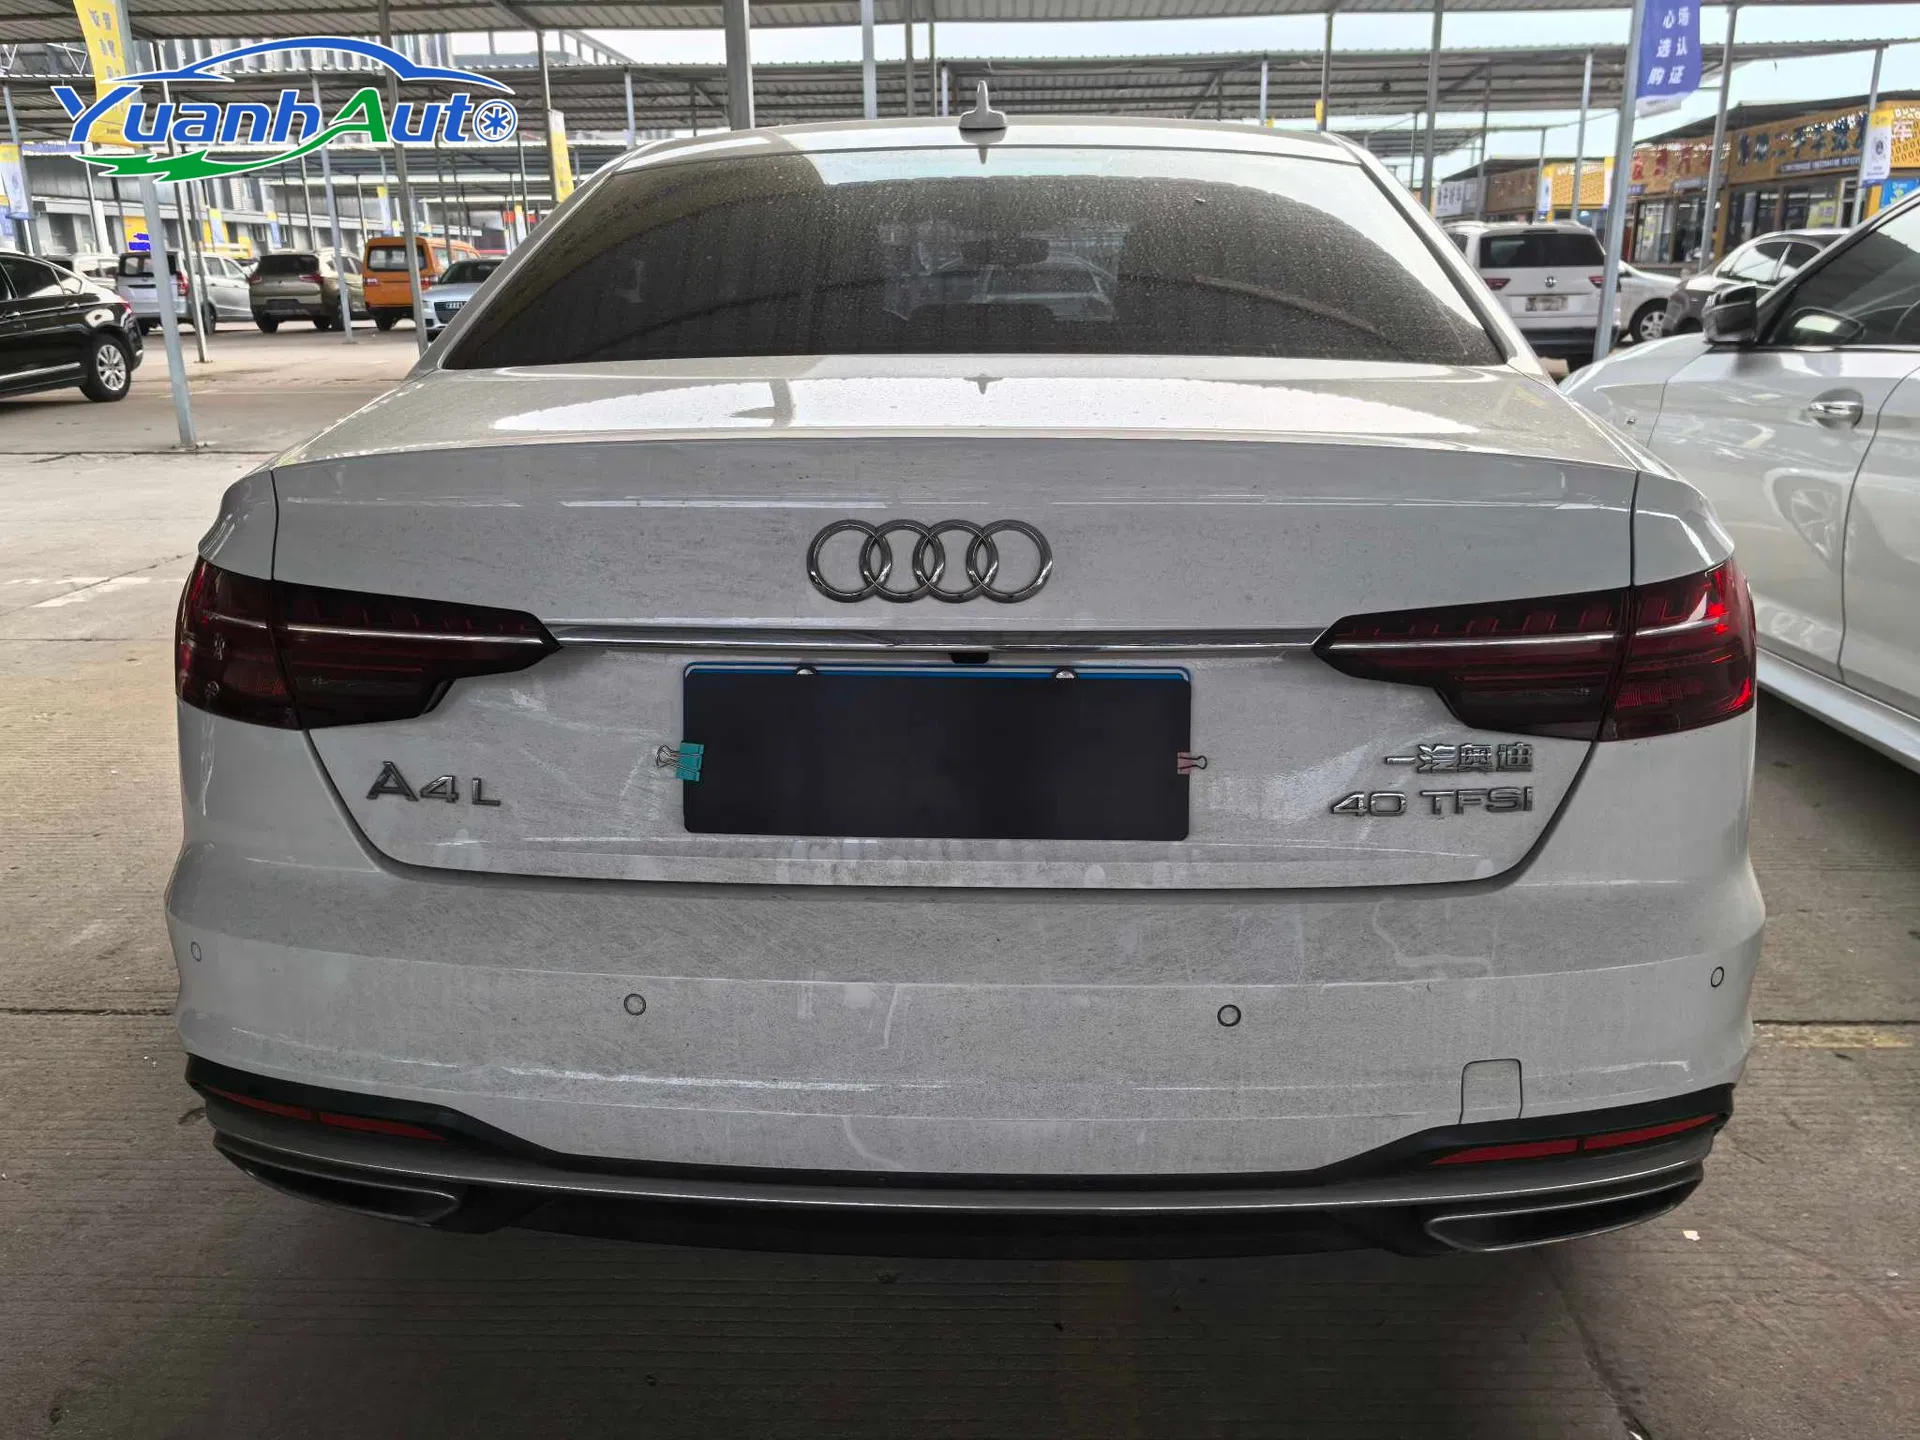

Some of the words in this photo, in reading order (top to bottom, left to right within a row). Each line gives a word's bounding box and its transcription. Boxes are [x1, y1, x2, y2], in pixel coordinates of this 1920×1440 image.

[1384, 742, 1533, 773] 一汽奥迪
[1331, 790, 1407, 816] 40
[1419, 786, 1533, 815] TFSI
